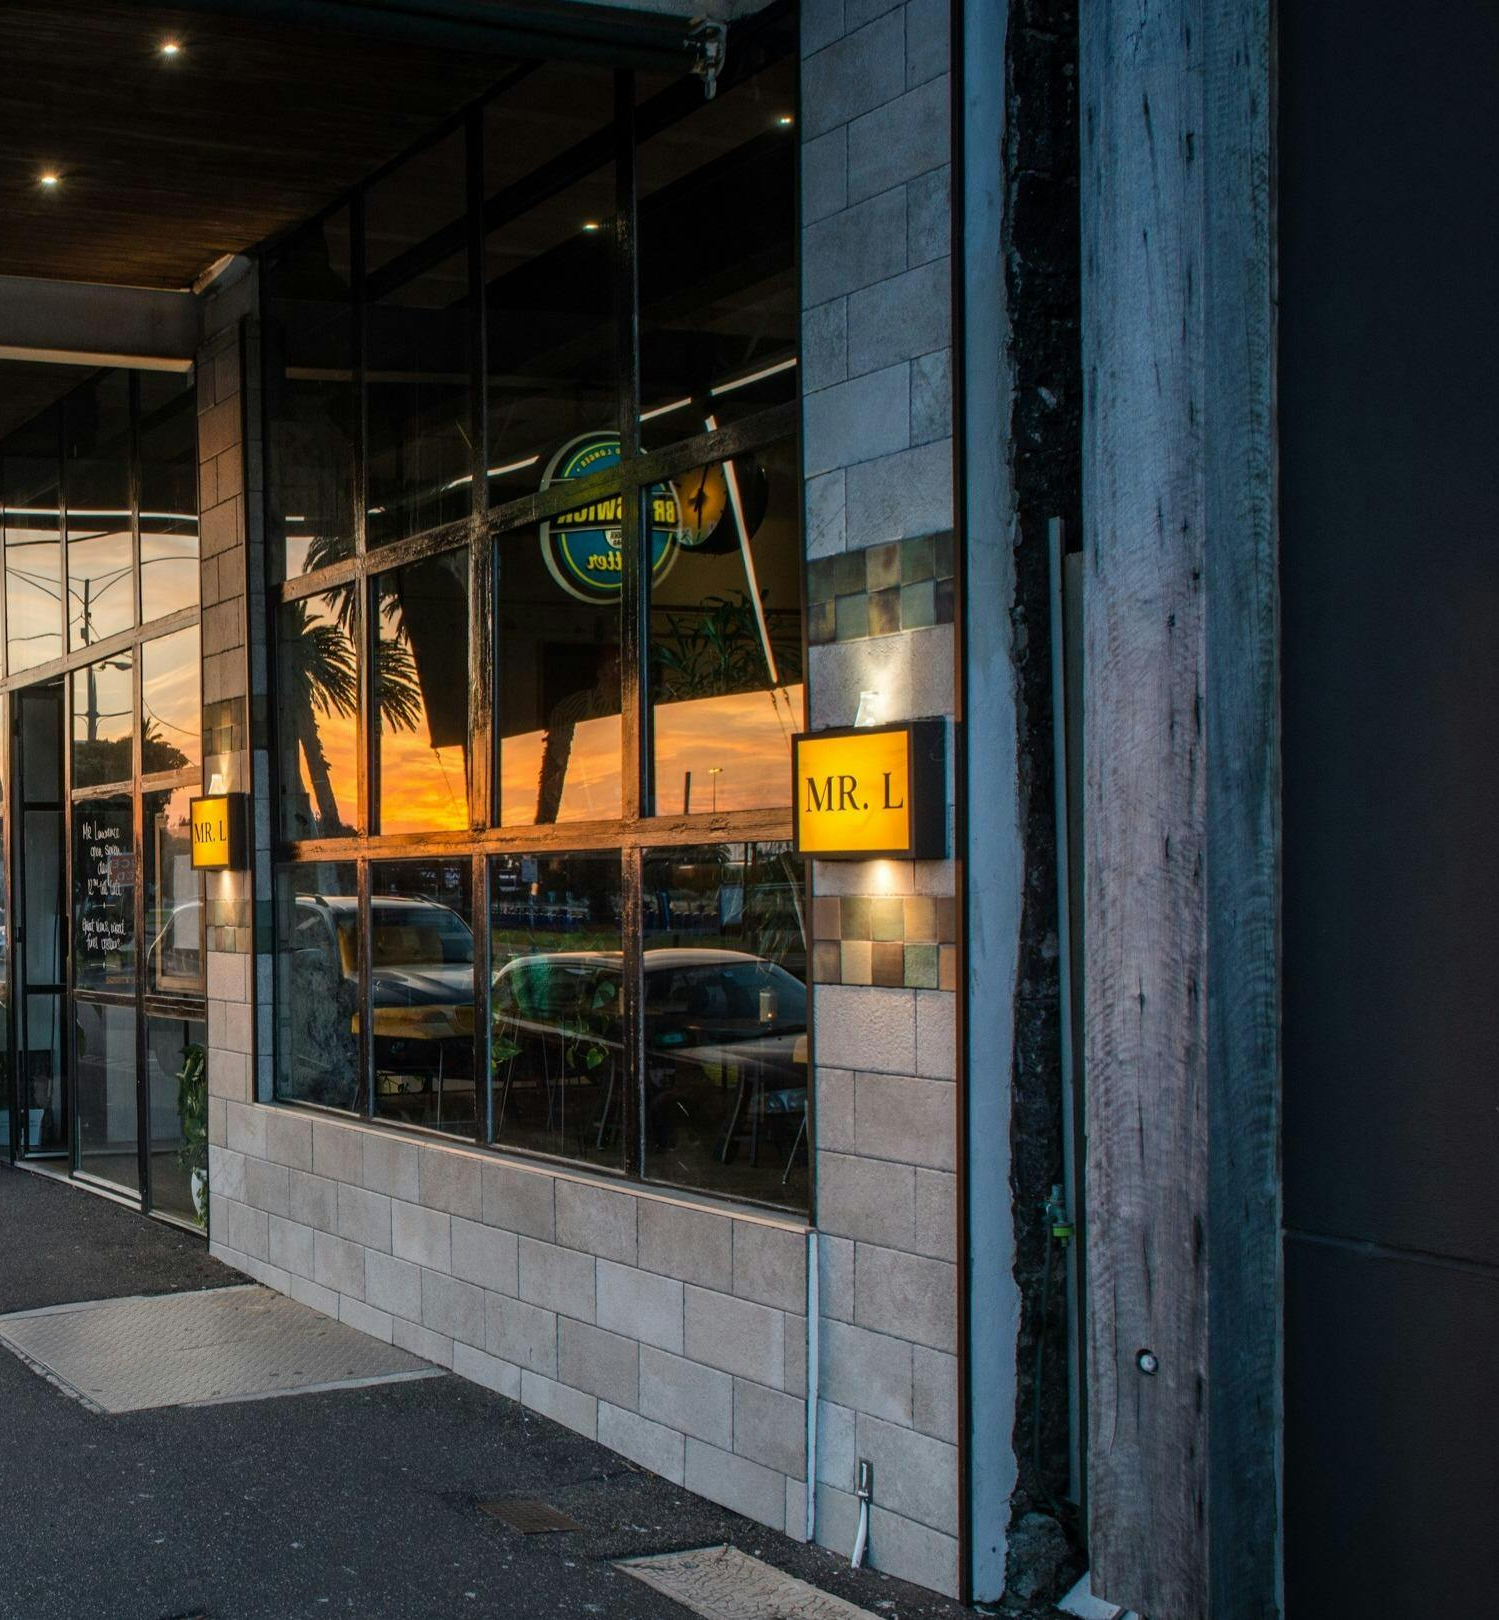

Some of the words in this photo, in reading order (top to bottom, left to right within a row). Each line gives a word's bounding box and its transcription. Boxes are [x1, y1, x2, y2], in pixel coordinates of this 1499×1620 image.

[805, 774, 869, 812] MR.
[882, 772, 904, 809] L
[194, 821, 216, 844] MR.
[219, 820, 227, 842] L
